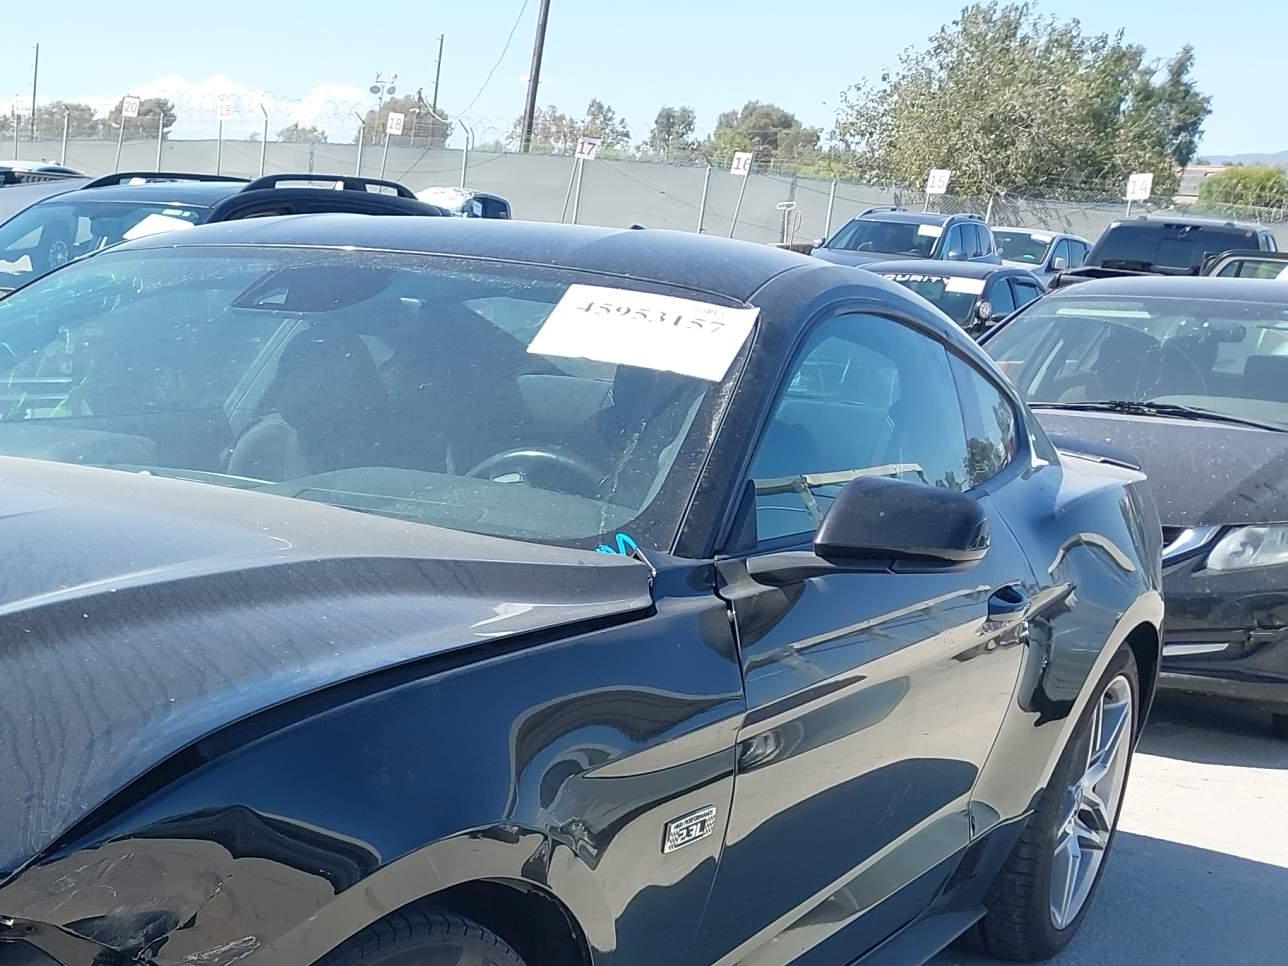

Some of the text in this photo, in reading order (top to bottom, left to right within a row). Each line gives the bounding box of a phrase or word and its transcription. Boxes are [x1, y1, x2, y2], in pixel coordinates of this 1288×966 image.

[124, 101, 138, 114] 20
[388, 117, 402, 131] 18
[576, 141, 597, 156] 17
[733, 157, 750, 171] 16
[928, 175, 946, 189] 15
[1130, 178, 1148, 195] 14
[576, 302, 726, 334] 45953157
